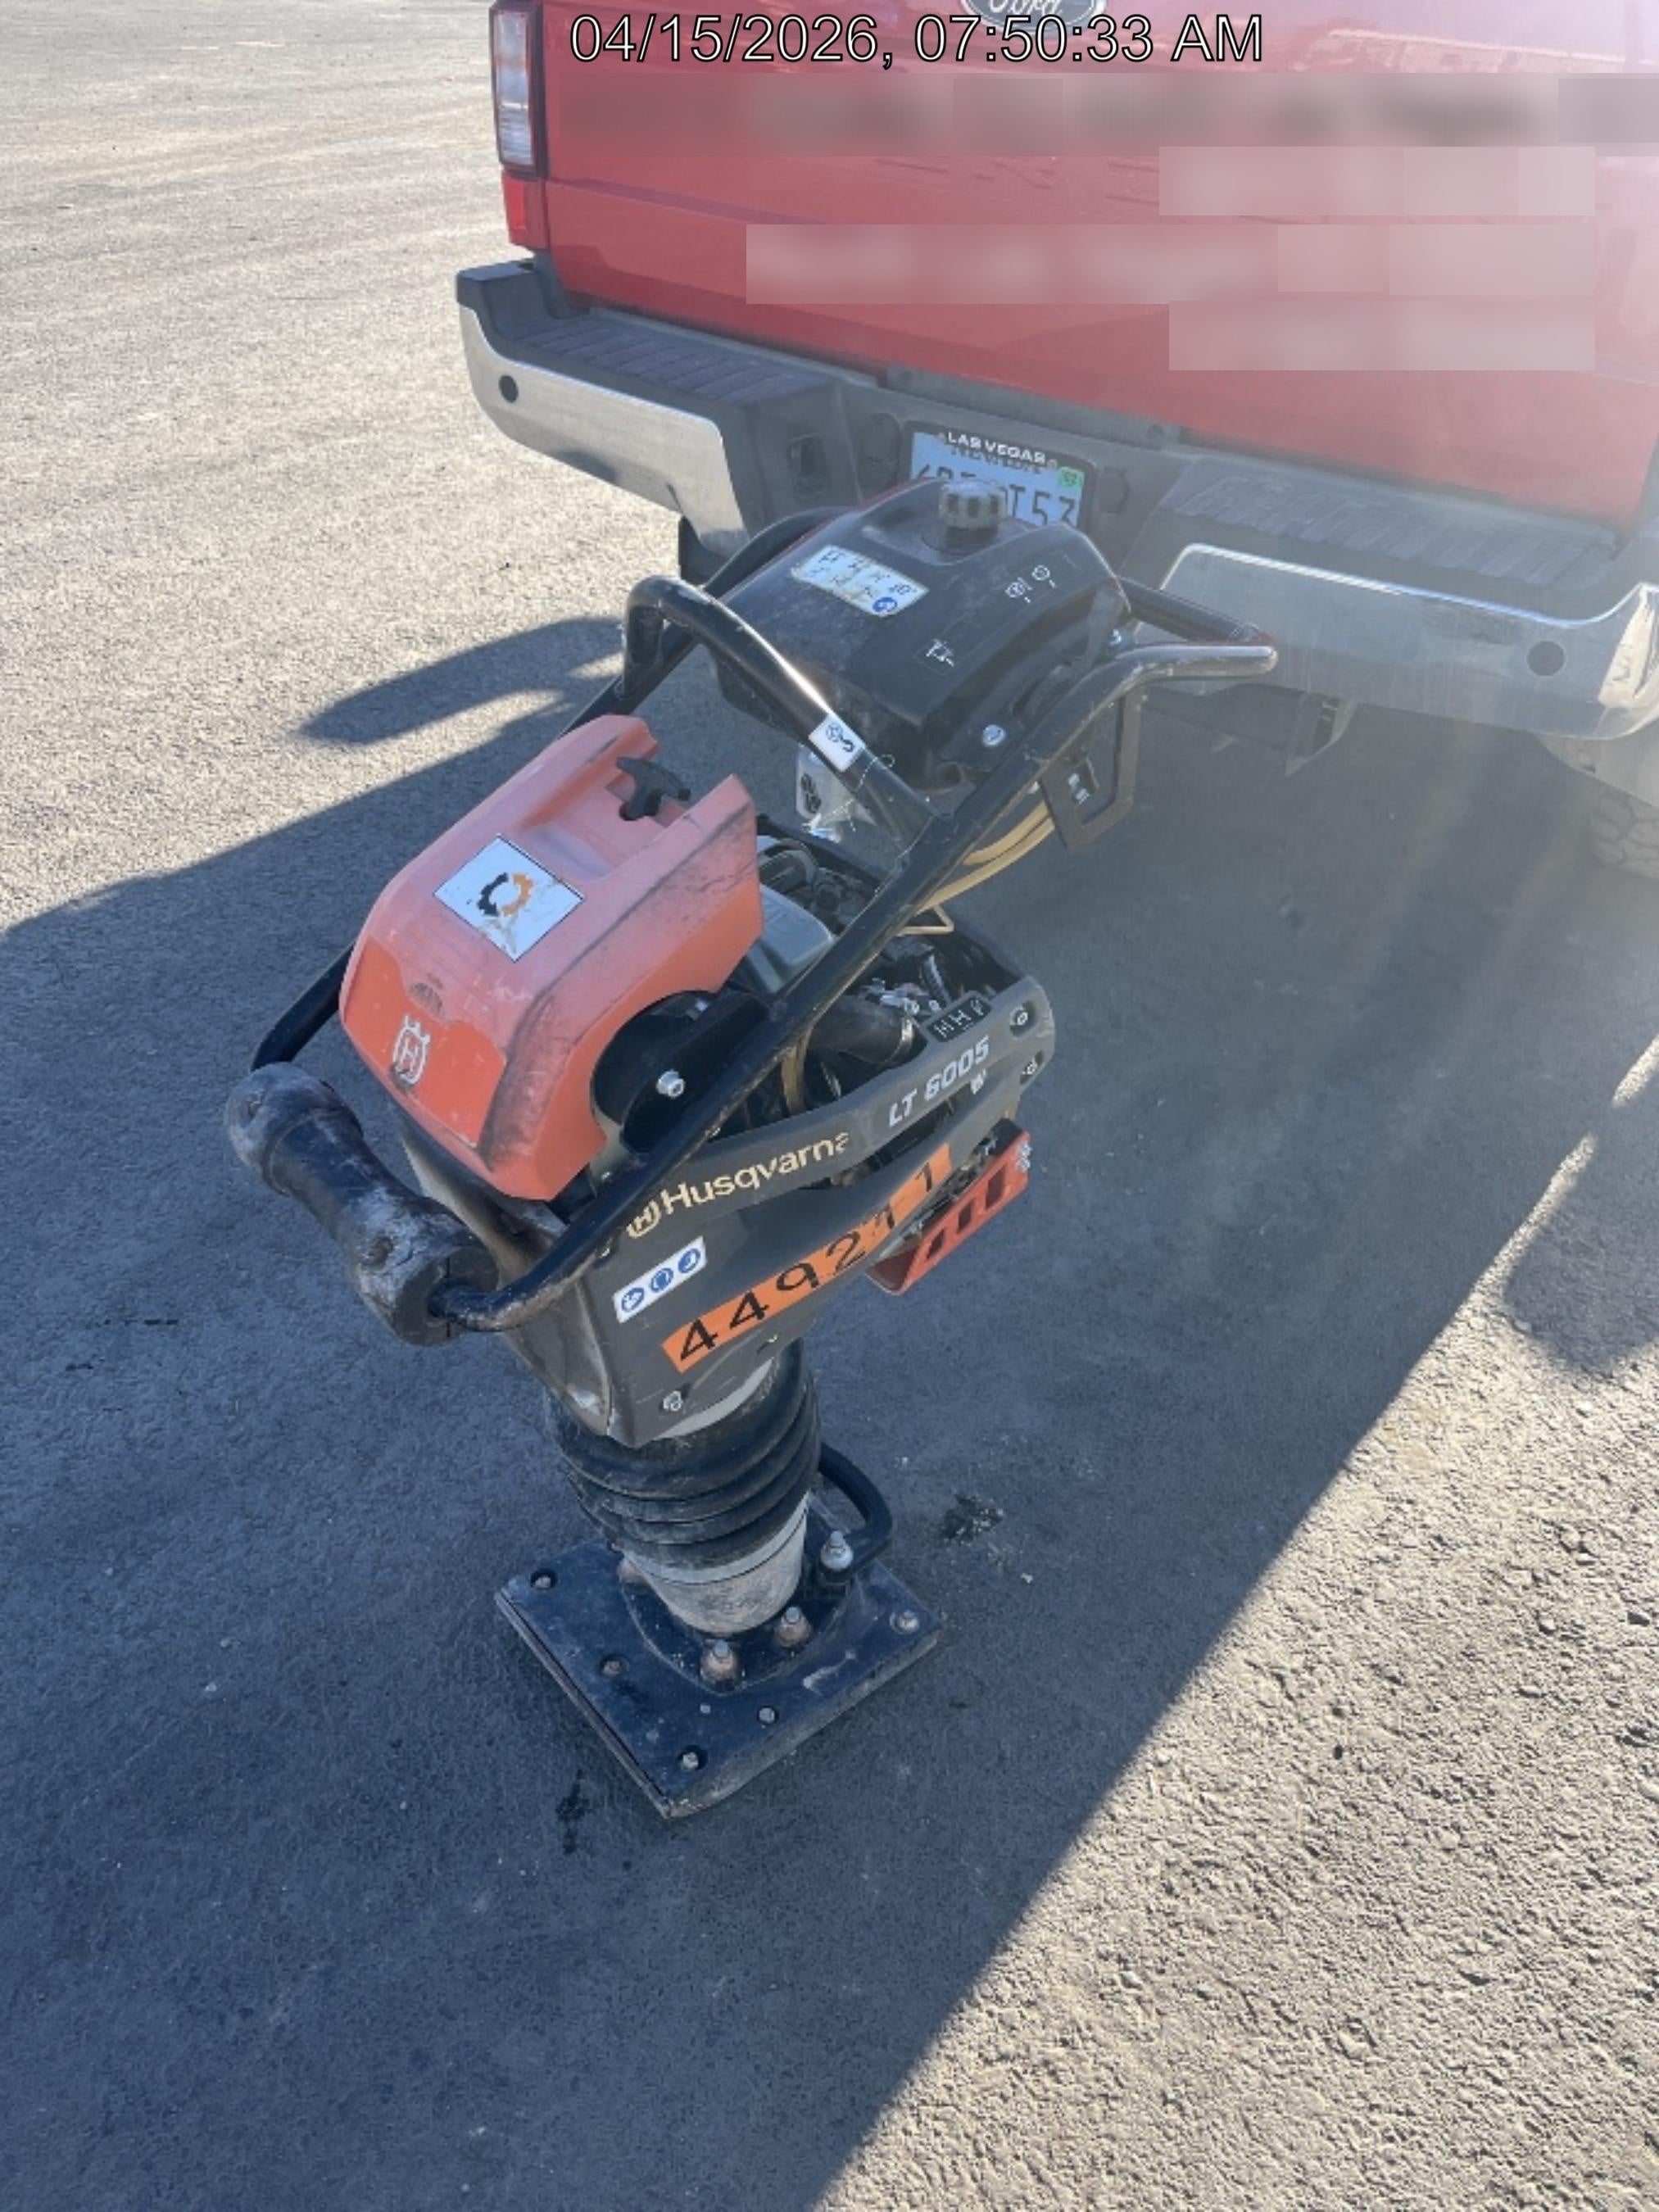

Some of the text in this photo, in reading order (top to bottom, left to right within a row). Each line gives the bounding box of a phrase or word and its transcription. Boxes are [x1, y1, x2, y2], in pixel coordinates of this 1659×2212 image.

[948, 432, 981, 448] LAS
[985, 440, 1045, 464] VEGAS
[887, 1036, 990, 1127] LT 6005
[660, 1131, 850, 1215] Husqvarna
